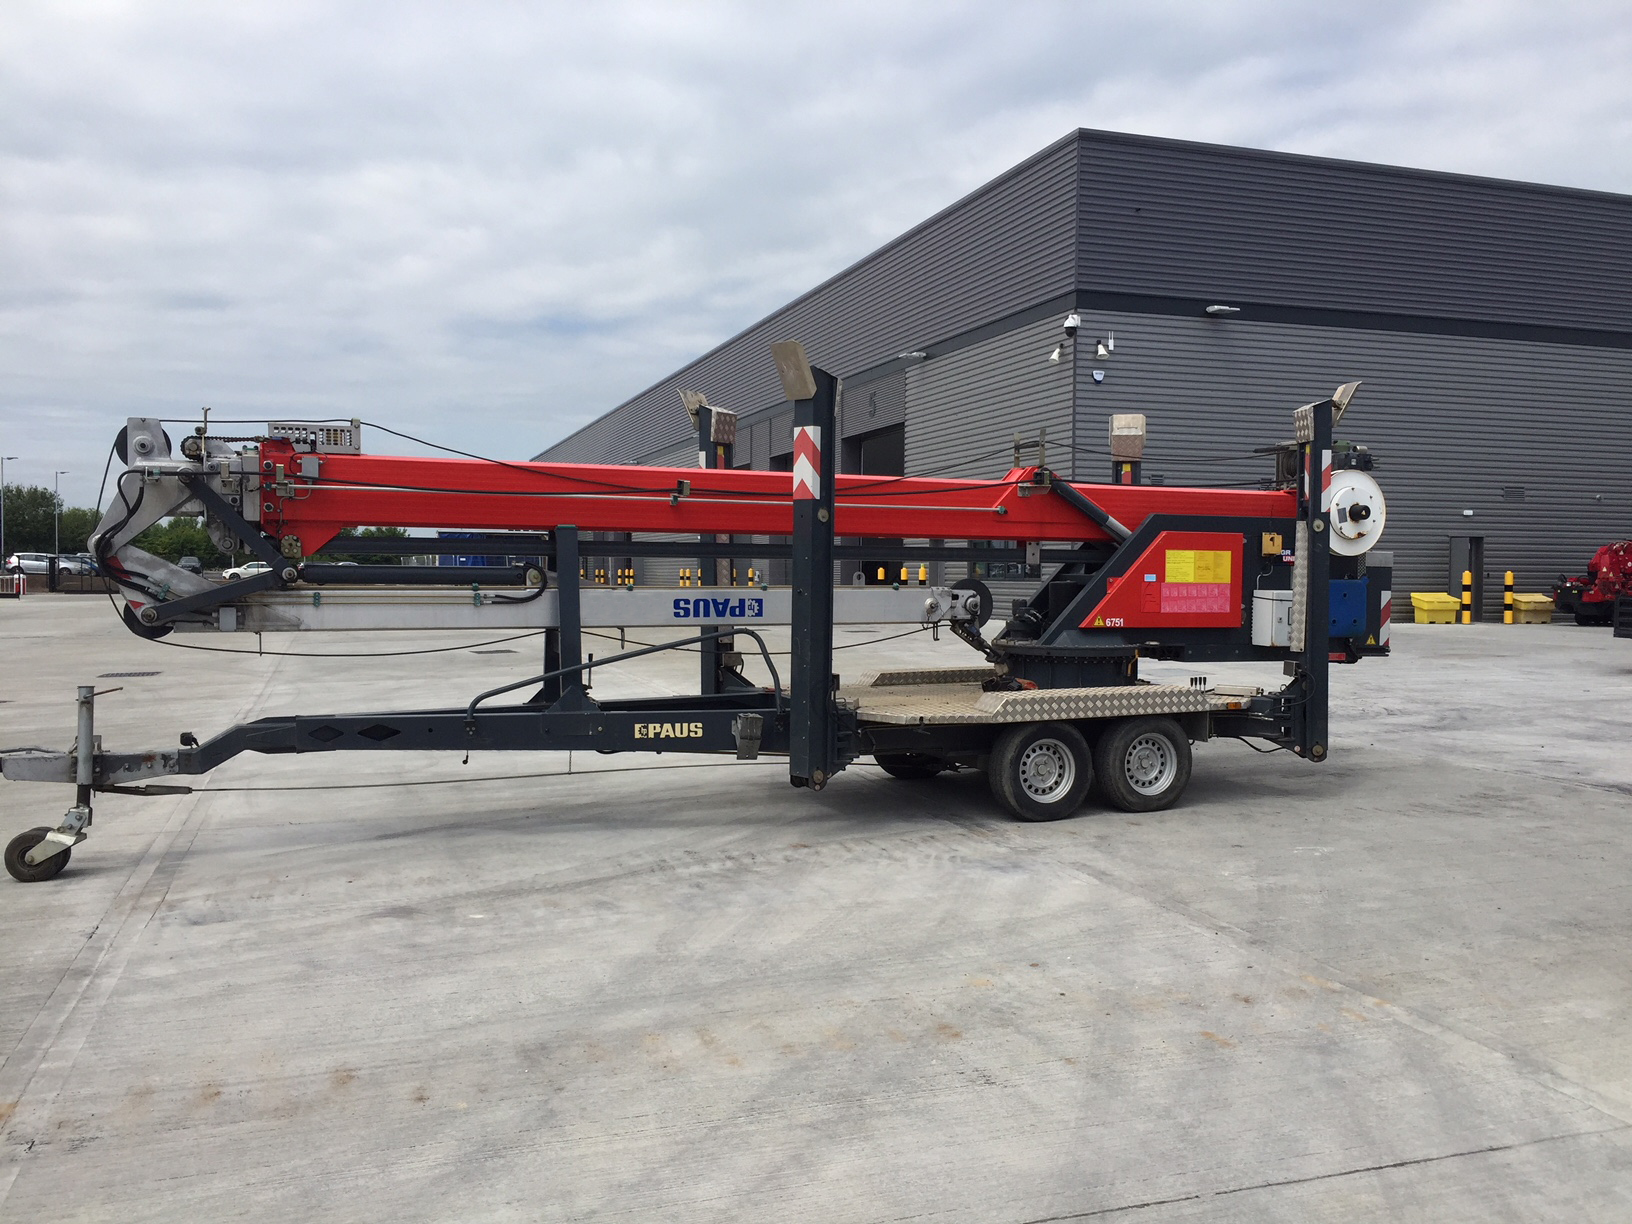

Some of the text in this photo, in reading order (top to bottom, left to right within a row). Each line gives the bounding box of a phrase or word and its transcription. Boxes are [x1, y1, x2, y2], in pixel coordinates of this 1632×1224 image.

[673, 598, 746, 618] PAUS
[1105, 617, 1124, 627] 6751
[648, 722, 703, 739] PAUS
